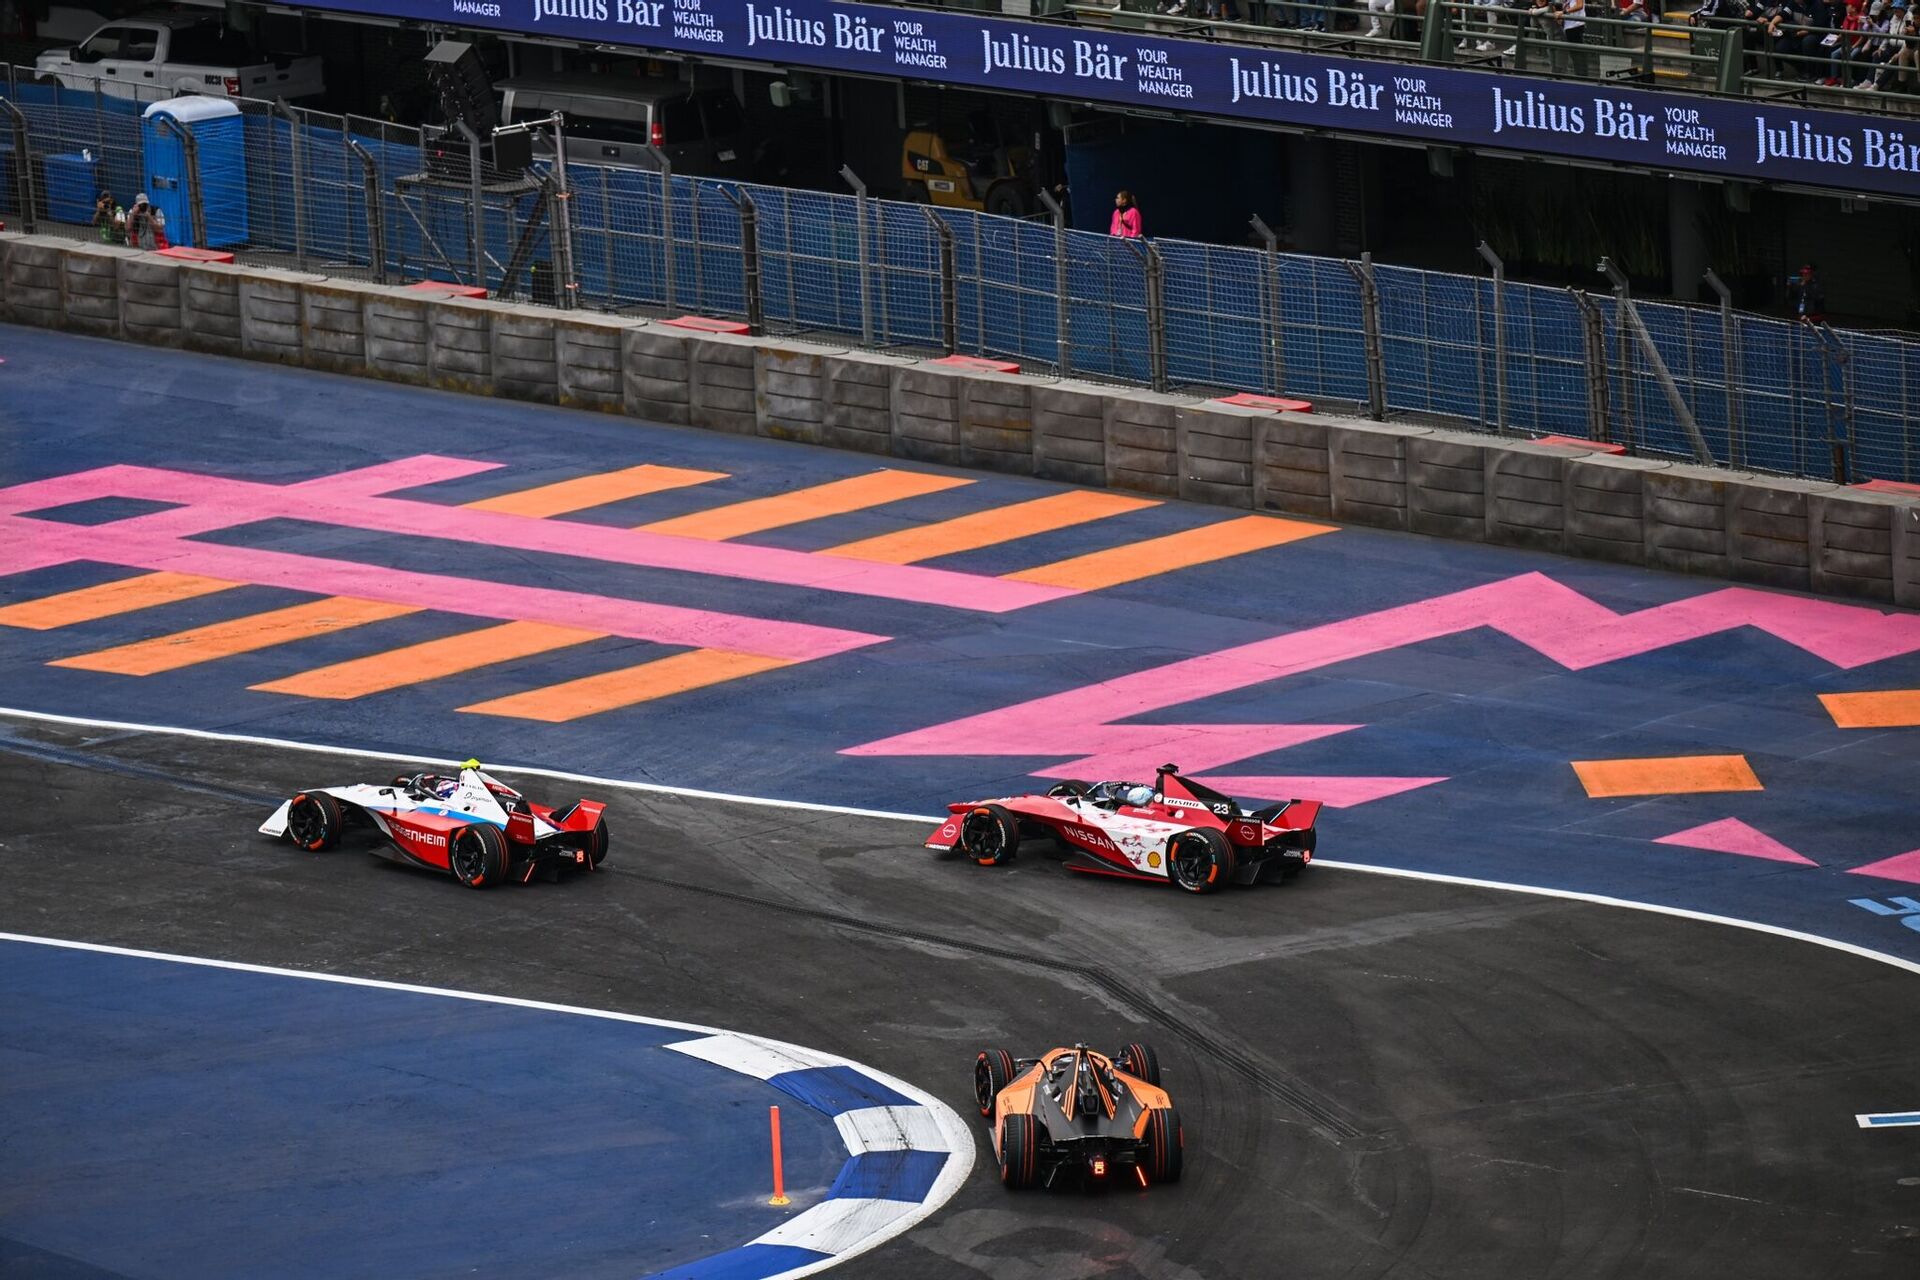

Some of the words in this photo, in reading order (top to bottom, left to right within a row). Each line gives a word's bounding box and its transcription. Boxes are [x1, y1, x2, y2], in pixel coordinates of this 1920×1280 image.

[453, 0, 501, 17] MANAGER
[672, 10, 714, 28] WEALTH
[746, 3, 826, 47] Julius
[832, 12, 886, 53] Bär
[893, 20, 923, 36] YOUR
[674, 25, 724, 43] MANAGER
[893, 35, 937, 53] WEALTH
[895, 51, 948, 69] MANAGER
[981, 29, 1066, 75] Julius
[1072, 39, 1128, 81] Bär
[1136, 47, 1168, 65] YOUR
[1136, 63, 1182, 82] WEALTH
[1138, 79, 1194, 99] MANAGER
[1229, 57, 1319, 104] Julius
[1326, 68, 1385, 111] Bär
[1393, 76, 1427, 94] YOUR
[1394, 92, 1442, 111] WEALTH
[1395, 108, 1453, 129] MANAGER
[1493, 88, 1586, 134] Julius
[1593, 98, 1655, 142] Bär
[1664, 106, 1700, 125] YOUR
[1665, 123, 1715, 143] WEALTH
[1666, 139, 1727, 161] MANAGER
[1755, 116, 1853, 165] Julius
[1862, 128, 1920, 173] Bär
[916, 158, 930, 171] CAT
[505, 801, 516, 812] 17
[1212, 803, 1230, 815] 23
[1063, 825, 1116, 852] NISSAN
